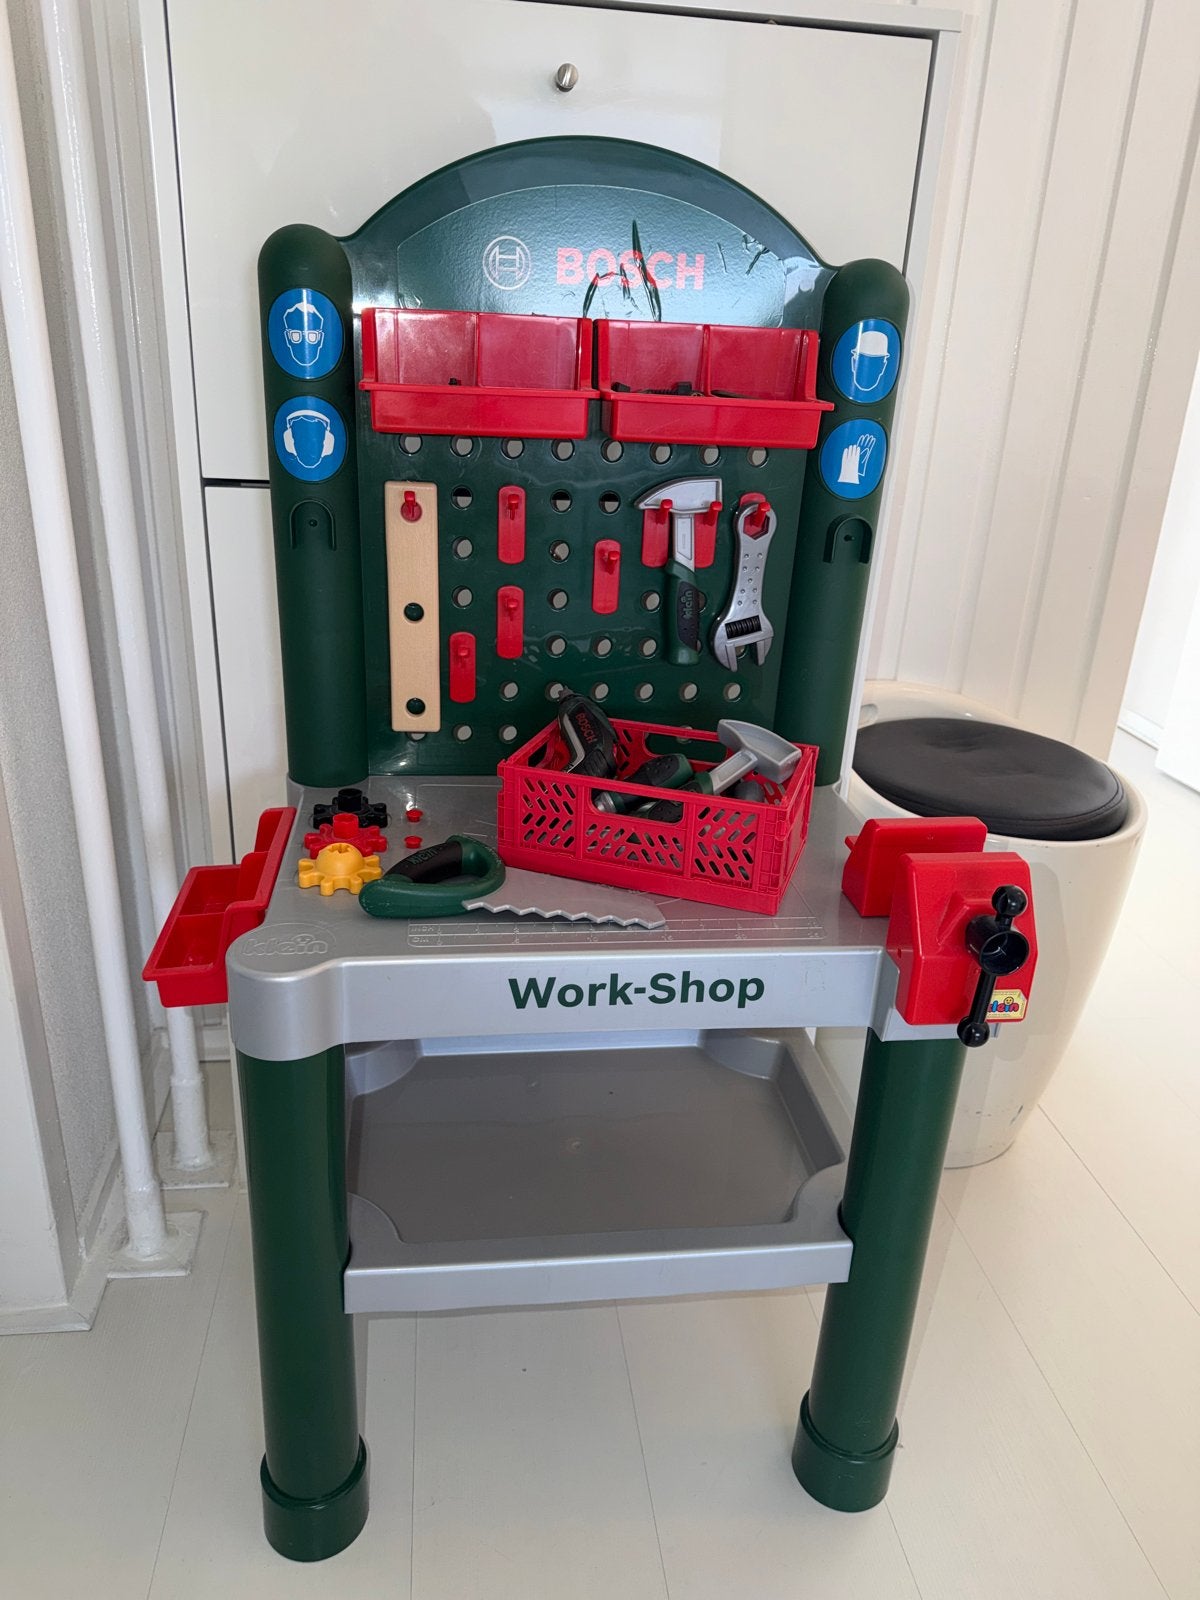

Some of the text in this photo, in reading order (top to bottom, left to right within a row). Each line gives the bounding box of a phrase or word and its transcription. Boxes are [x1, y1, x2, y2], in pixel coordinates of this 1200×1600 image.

[556, 247, 705, 290] BOSCH
[575, 712, 598, 744] BOSCH
[242, 935, 329, 956] klein
[508, 970, 765, 1009] Work-Shop
